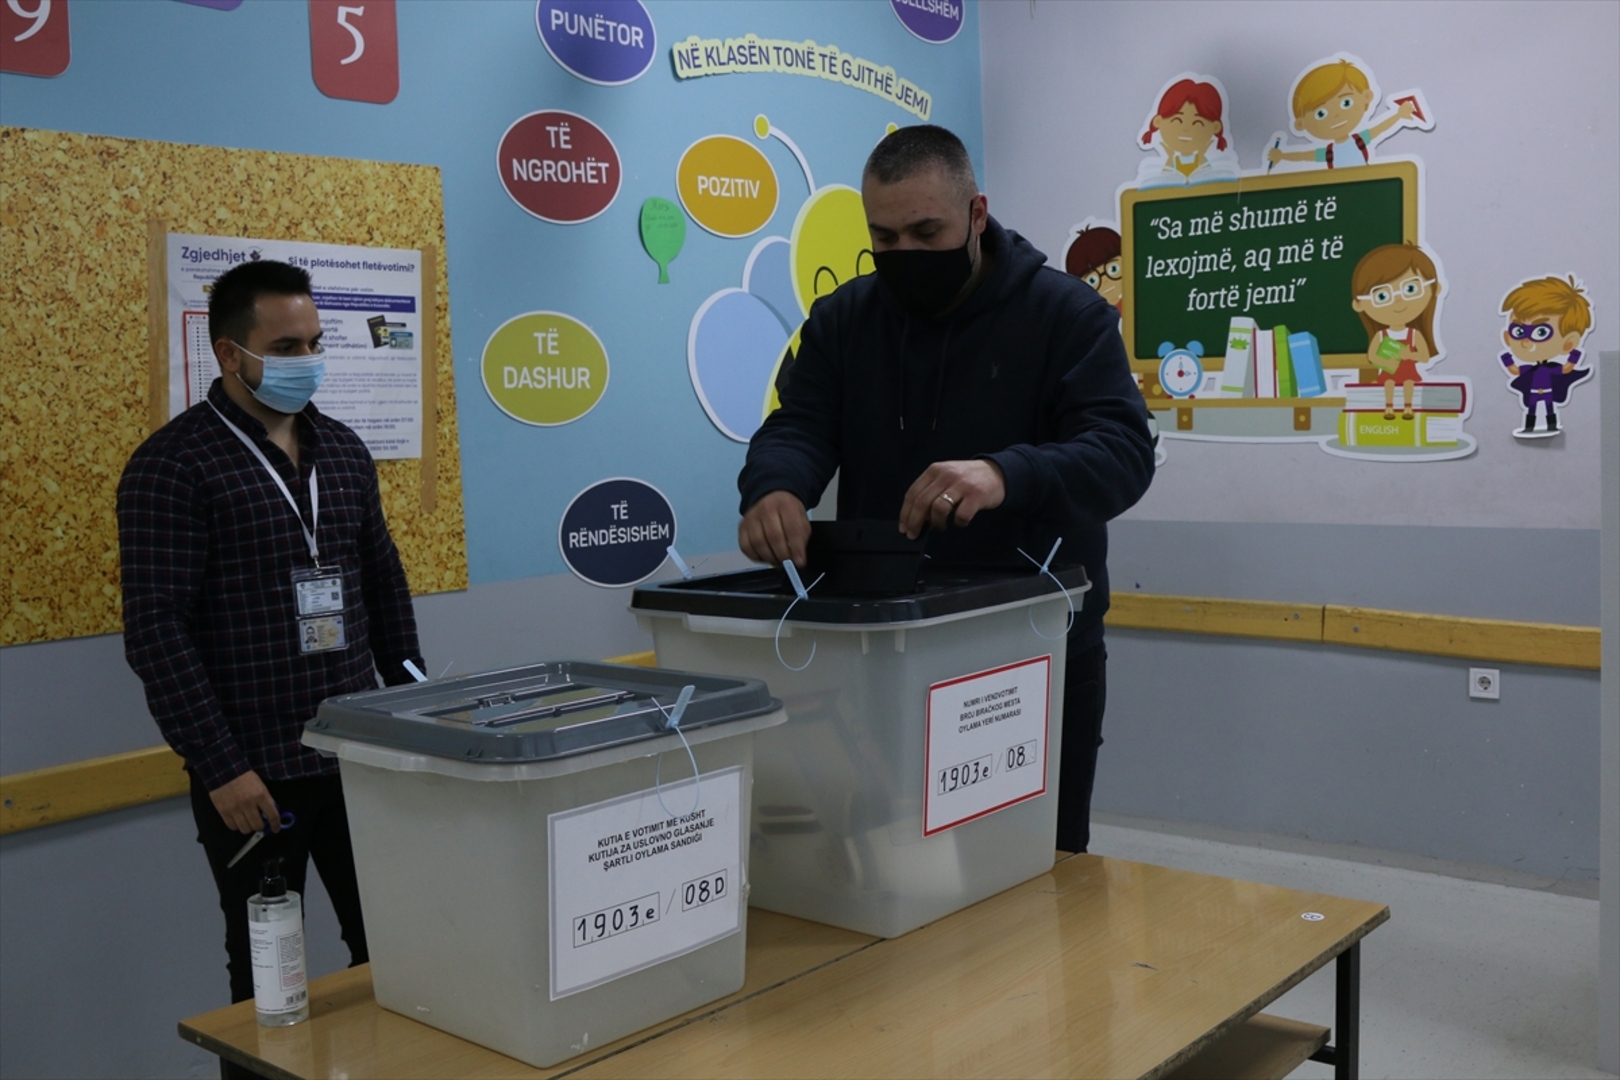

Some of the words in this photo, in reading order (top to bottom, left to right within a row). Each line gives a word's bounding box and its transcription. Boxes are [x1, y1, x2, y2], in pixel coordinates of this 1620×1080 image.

[337, 6, 365, 65] 5
[551, 8, 644, 49] PUNËTOR
[678, 43, 702, 70] NË
[705, 40, 770, 67] KLASËN
[773, 46, 816, 71] TONË
[818, 51, 838, 75] TË
[841, 59, 893, 95] GJITHË
[895, 84, 929, 116] JEMI
[545, 122, 572, 149] TË
[512, 157, 609, 184] NGROHËT
[697, 175, 760, 199] POZITIV
[1188, 211, 1223, 236] më
[1229, 200, 1307, 231] shumë
[1315, 196, 1337, 221] të
[181, 246, 246, 265] Zgjedhjet
[299, 257, 308, 267] të
[310, 259, 360, 270] plotësohet
[362, 261, 415, 273] fletëvotimi?
[1145, 248, 1237, 279] lexojmë,
[1244, 247, 1271, 271] aq
[1277, 239, 1314, 265] më
[1321, 235, 1343, 260] të
[1186, 284, 1239, 311] fortë
[533, 328, 560, 355] TË
[503, 366, 591, 390] DASHUR
[1360, 425, 1399, 435] ENGLISH
[610, 500, 628, 520] TË
[569, 521, 669, 548] RËNDËSISHËM
[588, 848, 619, 863] KUTIJA
[620, 843, 632, 853] ZA
[633, 831, 672, 850] USLOVNO
[673, 818, 715, 837] GLASANJE
[597, 833, 623, 848] KUTIA
[624, 831, 631, 840] E
[632, 821, 665, 838] VOTIMIT
[666, 817, 678, 828] ME
[680, 809, 706, 824] KUSHT
[634, 844, 669, 860] OYLAMA
